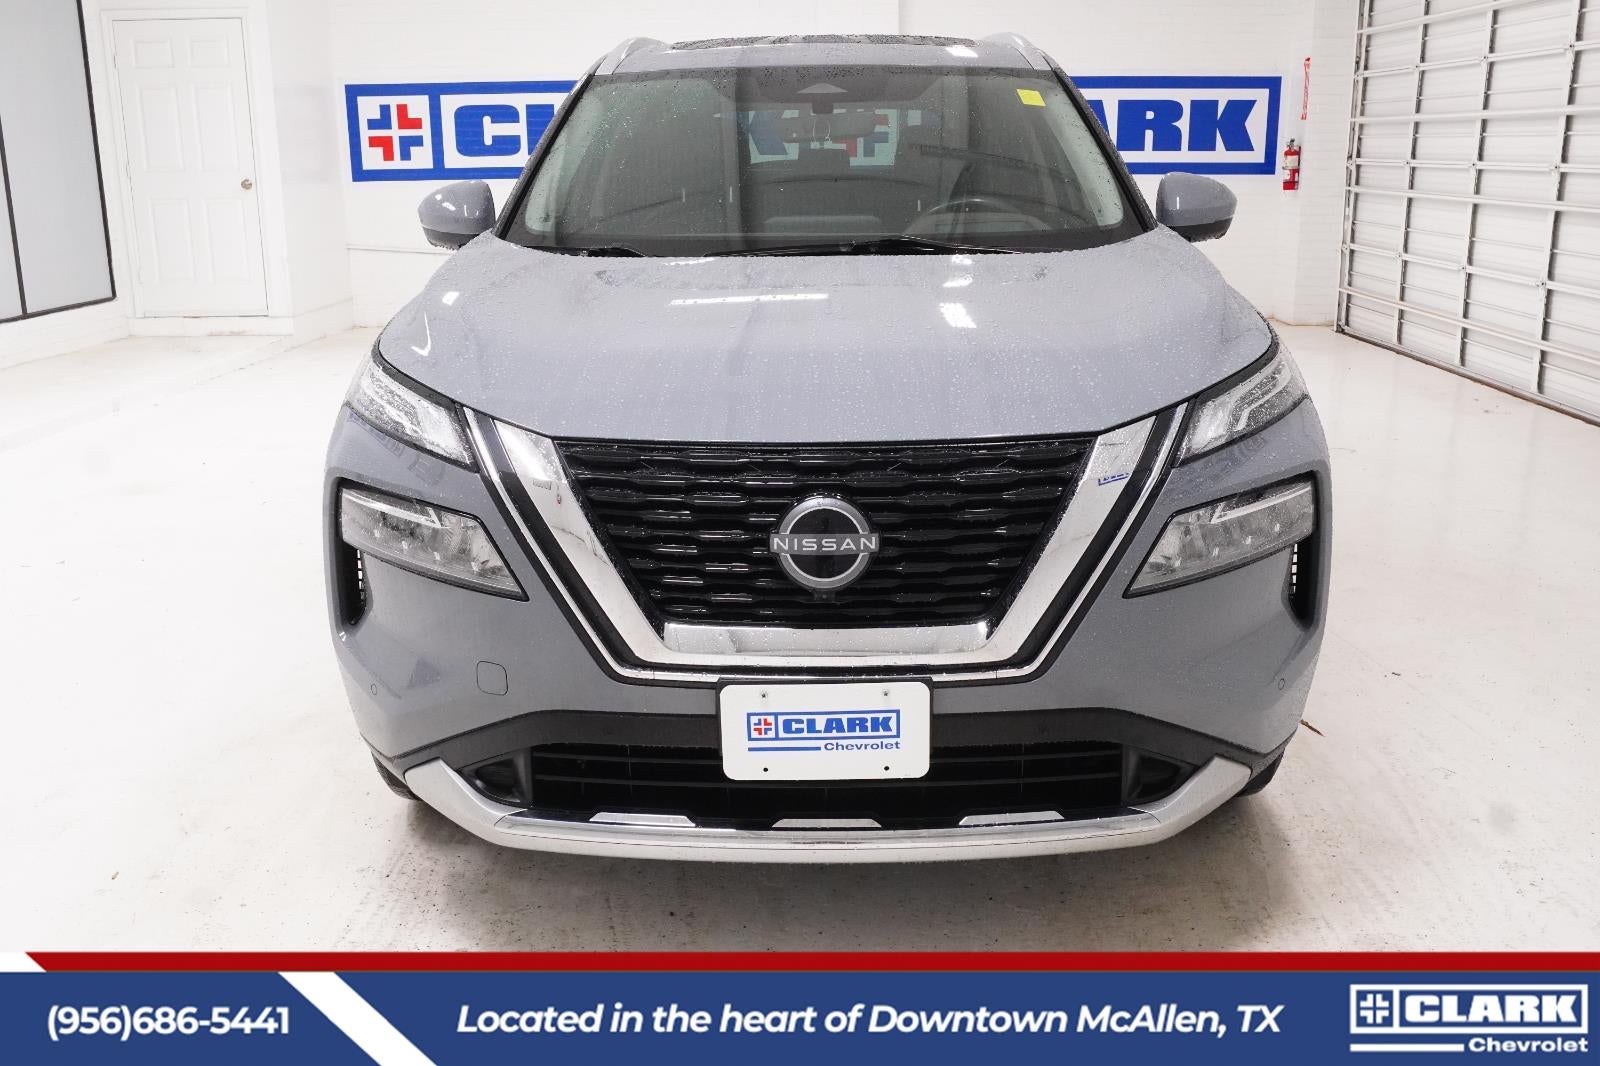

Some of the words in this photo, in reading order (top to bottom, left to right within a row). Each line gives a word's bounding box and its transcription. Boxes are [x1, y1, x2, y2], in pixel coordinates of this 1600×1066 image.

[773, 537, 876, 550] NISSAN
[782, 716, 892, 734] CLARK
[823, 740, 901, 751] Chevrolet
